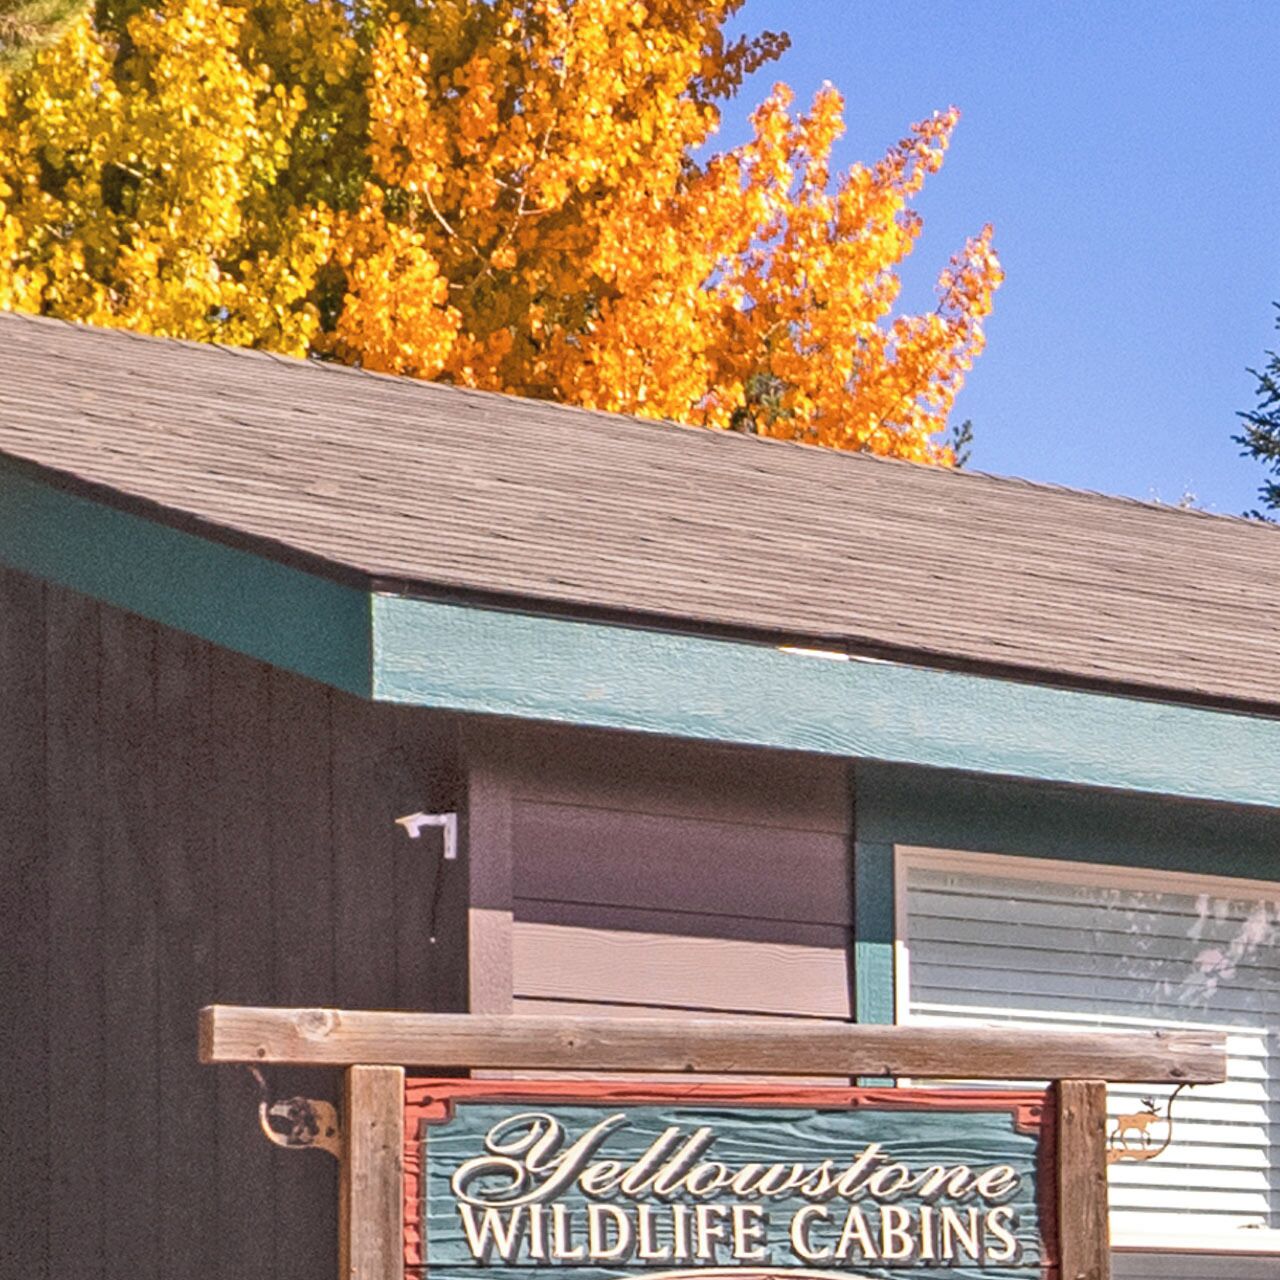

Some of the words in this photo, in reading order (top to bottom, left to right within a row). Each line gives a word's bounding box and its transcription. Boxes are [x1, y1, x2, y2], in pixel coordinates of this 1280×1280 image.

[452, 1112, 1018, 1207] Yellowstone
[456, 1203, 768, 1260] WILDLIFE
[790, 1204, 1018, 1261] CABINS
